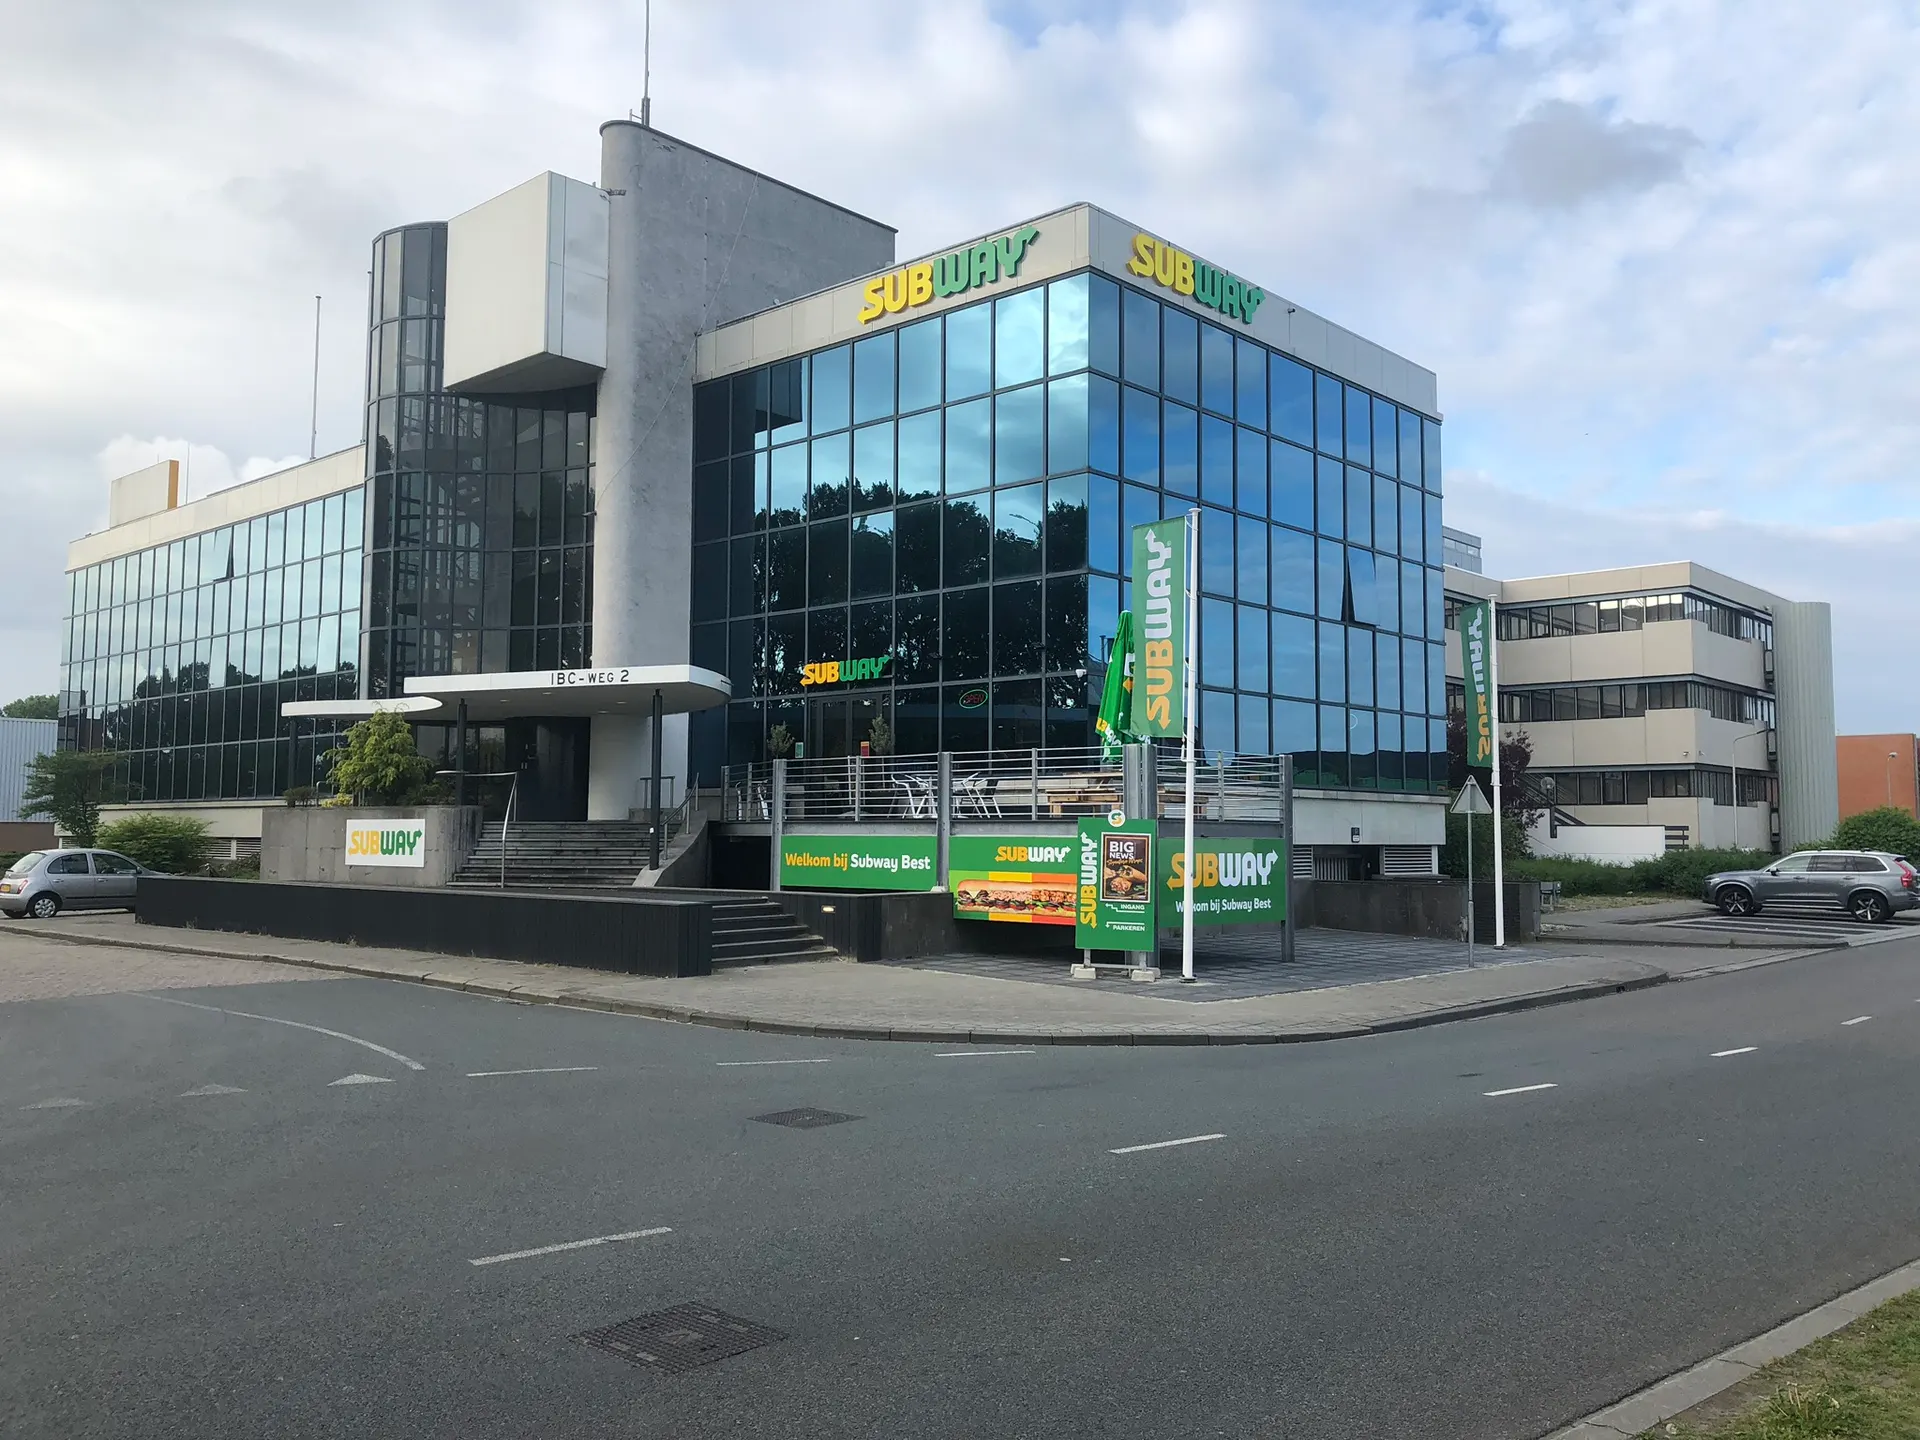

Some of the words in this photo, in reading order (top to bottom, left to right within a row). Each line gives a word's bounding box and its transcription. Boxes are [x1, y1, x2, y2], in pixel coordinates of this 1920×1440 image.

[857, 225, 1039, 325] SUBWAY
[1126, 233, 1266, 324] SUBWAY
[1145, 528, 1174, 730] SUBWAY
[551, 672, 614, 686] IBC-WEG
[620, 670, 629, 683] 2
[800, 655, 890, 687] SUBWAY
[348, 829, 422, 856] SUBWAY
[1109, 841, 1134, 853] BIG
[785, 852, 830, 867] Welkom
[833, 853, 848, 871] bij
[850, 854, 898, 873] Subway
[901, 854, 931, 870] Best
[994, 845, 1071, 862] SUBWAY
[1109, 851, 1134, 860] NEWS
[1080, 832, 1098, 929] SUBWAY
[1120, 903, 1145, 911] INGANG
[1175, 900, 1209, 913] Wkom
[1210, 898, 1220, 914] bij
[1221, 897, 1252, 912] Subway
[1254, 897, 1271, 909] Best
[1112, 924, 1145, 932] PARKEREN
